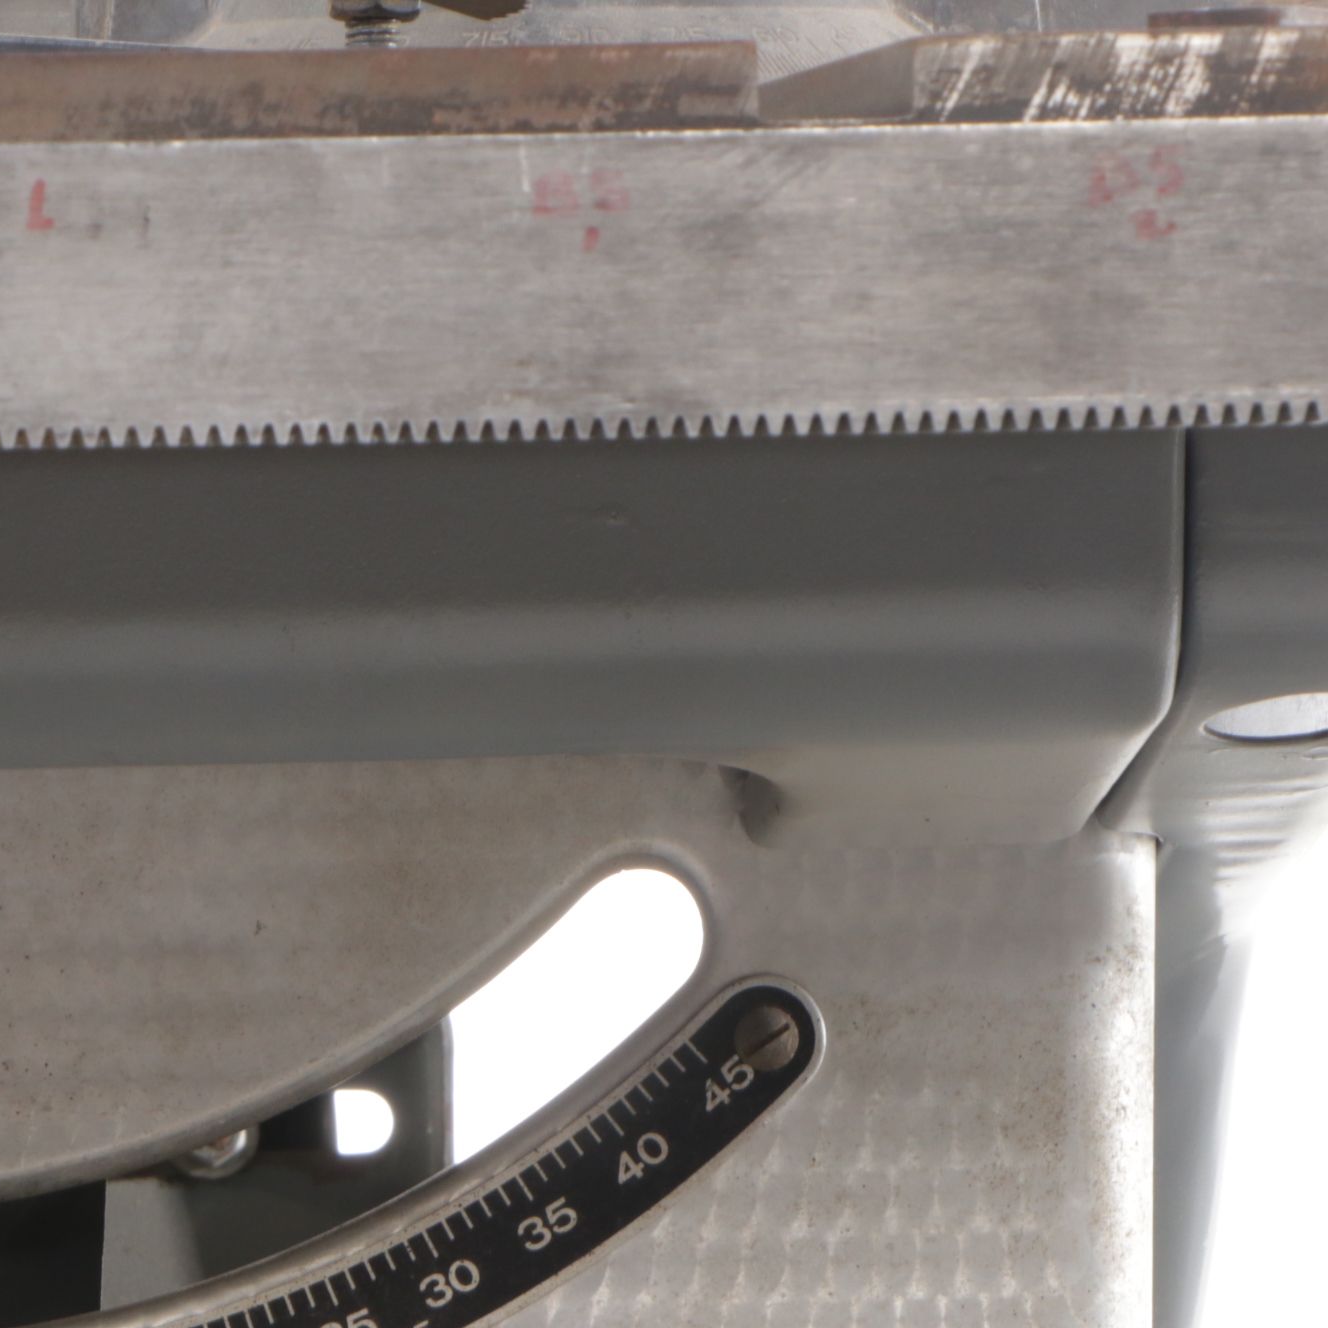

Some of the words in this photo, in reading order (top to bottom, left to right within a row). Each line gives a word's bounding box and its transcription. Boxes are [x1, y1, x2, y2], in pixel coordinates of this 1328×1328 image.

[26, 177, 55, 231] L
[419, 1259, 480, 1308] 30
[517, 1197, 578, 1251] 35
[617, 1132, 669, 1185] 40
[705, 1056, 755, 1112] 45
